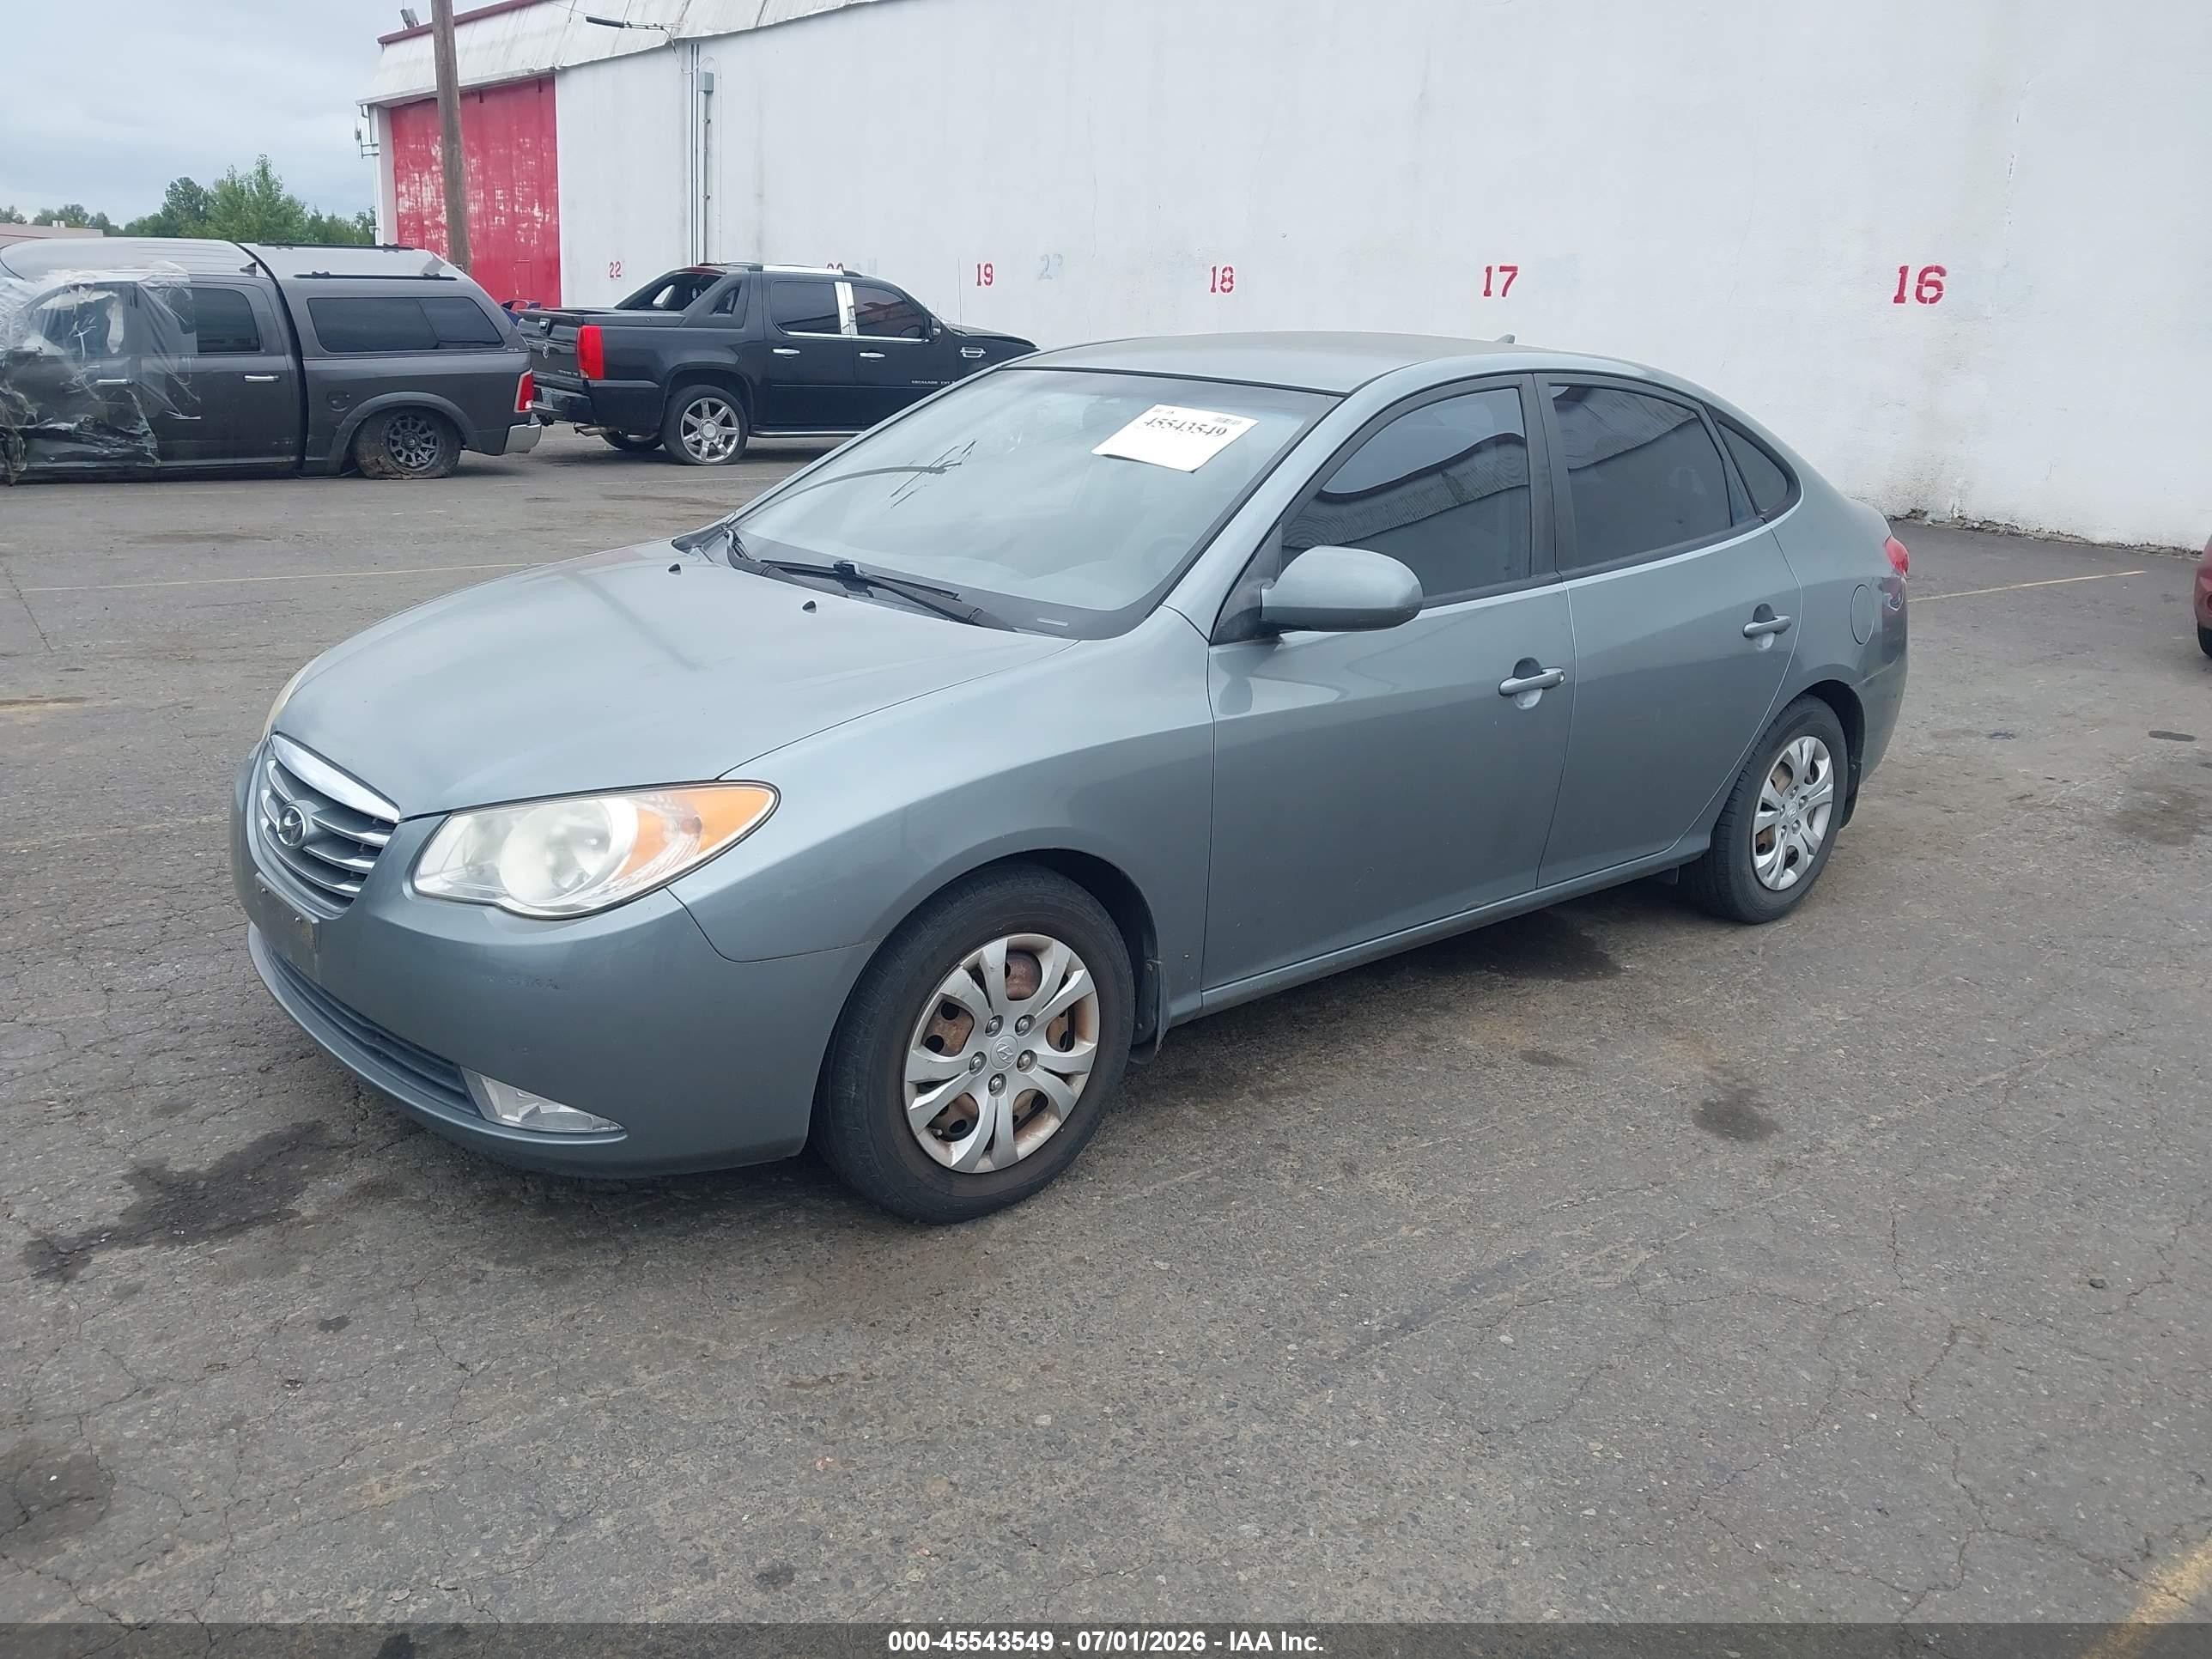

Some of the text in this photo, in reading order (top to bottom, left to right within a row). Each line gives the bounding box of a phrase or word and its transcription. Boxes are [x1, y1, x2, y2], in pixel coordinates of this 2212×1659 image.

[609, 261, 622, 278] 22
[976, 263, 994, 287] 19
[1210, 265, 1234, 294] 18
[1483, 265, 1519, 297] 17
[1893, 264, 1948, 305] 16
[1143, 417, 1228, 436] 45543549
